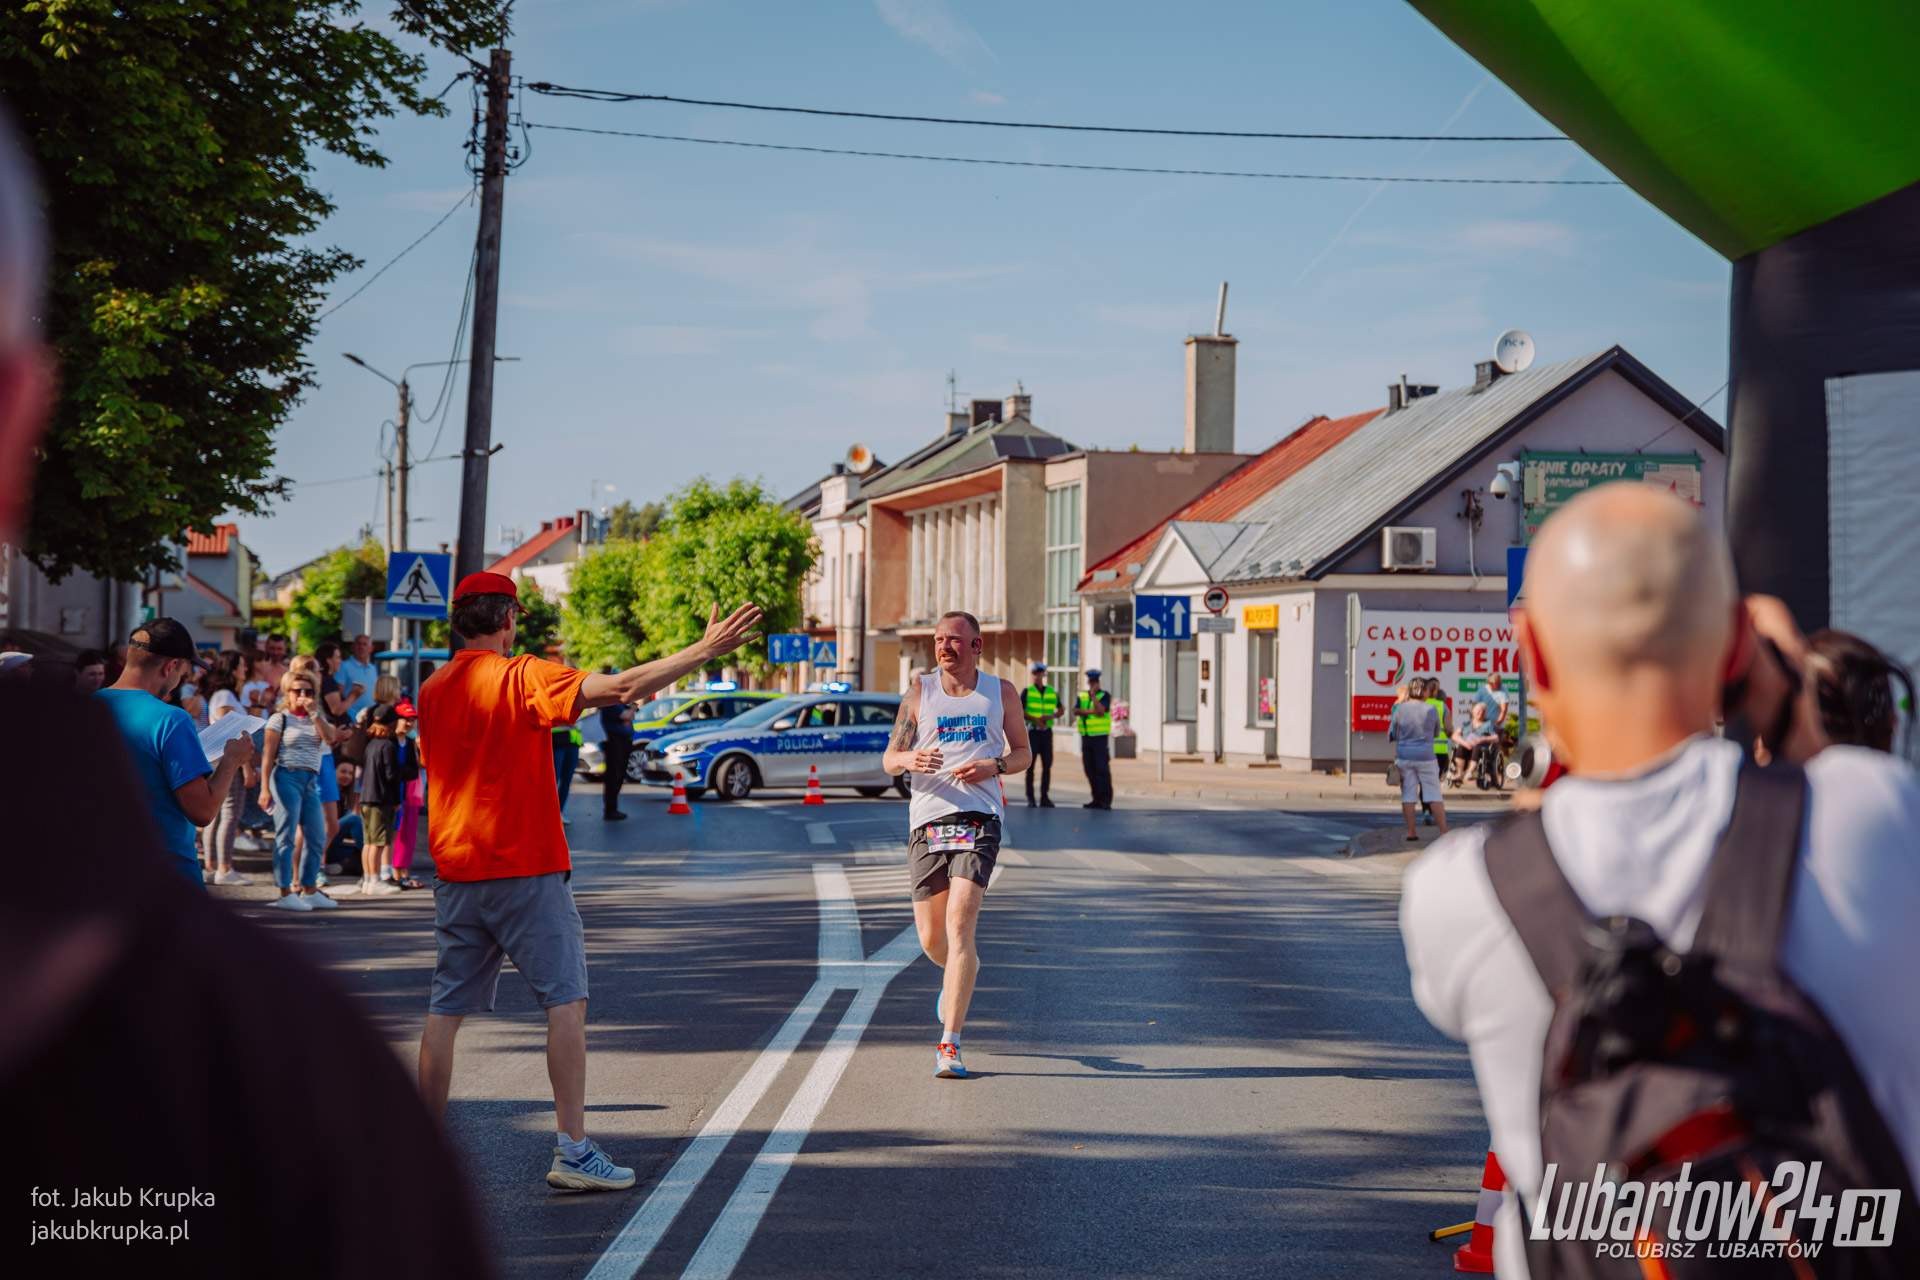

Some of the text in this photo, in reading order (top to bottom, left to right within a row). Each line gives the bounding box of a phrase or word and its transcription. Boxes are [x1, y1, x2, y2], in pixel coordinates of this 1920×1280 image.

[1571, 462, 1627, 476] OPŁATY
[1367, 625, 1516, 642] CAŁODOBOW
[937, 714, 987, 728] Mountain
[777, 738, 823, 750] POLICJA
[935, 824, 969, 839] 135
